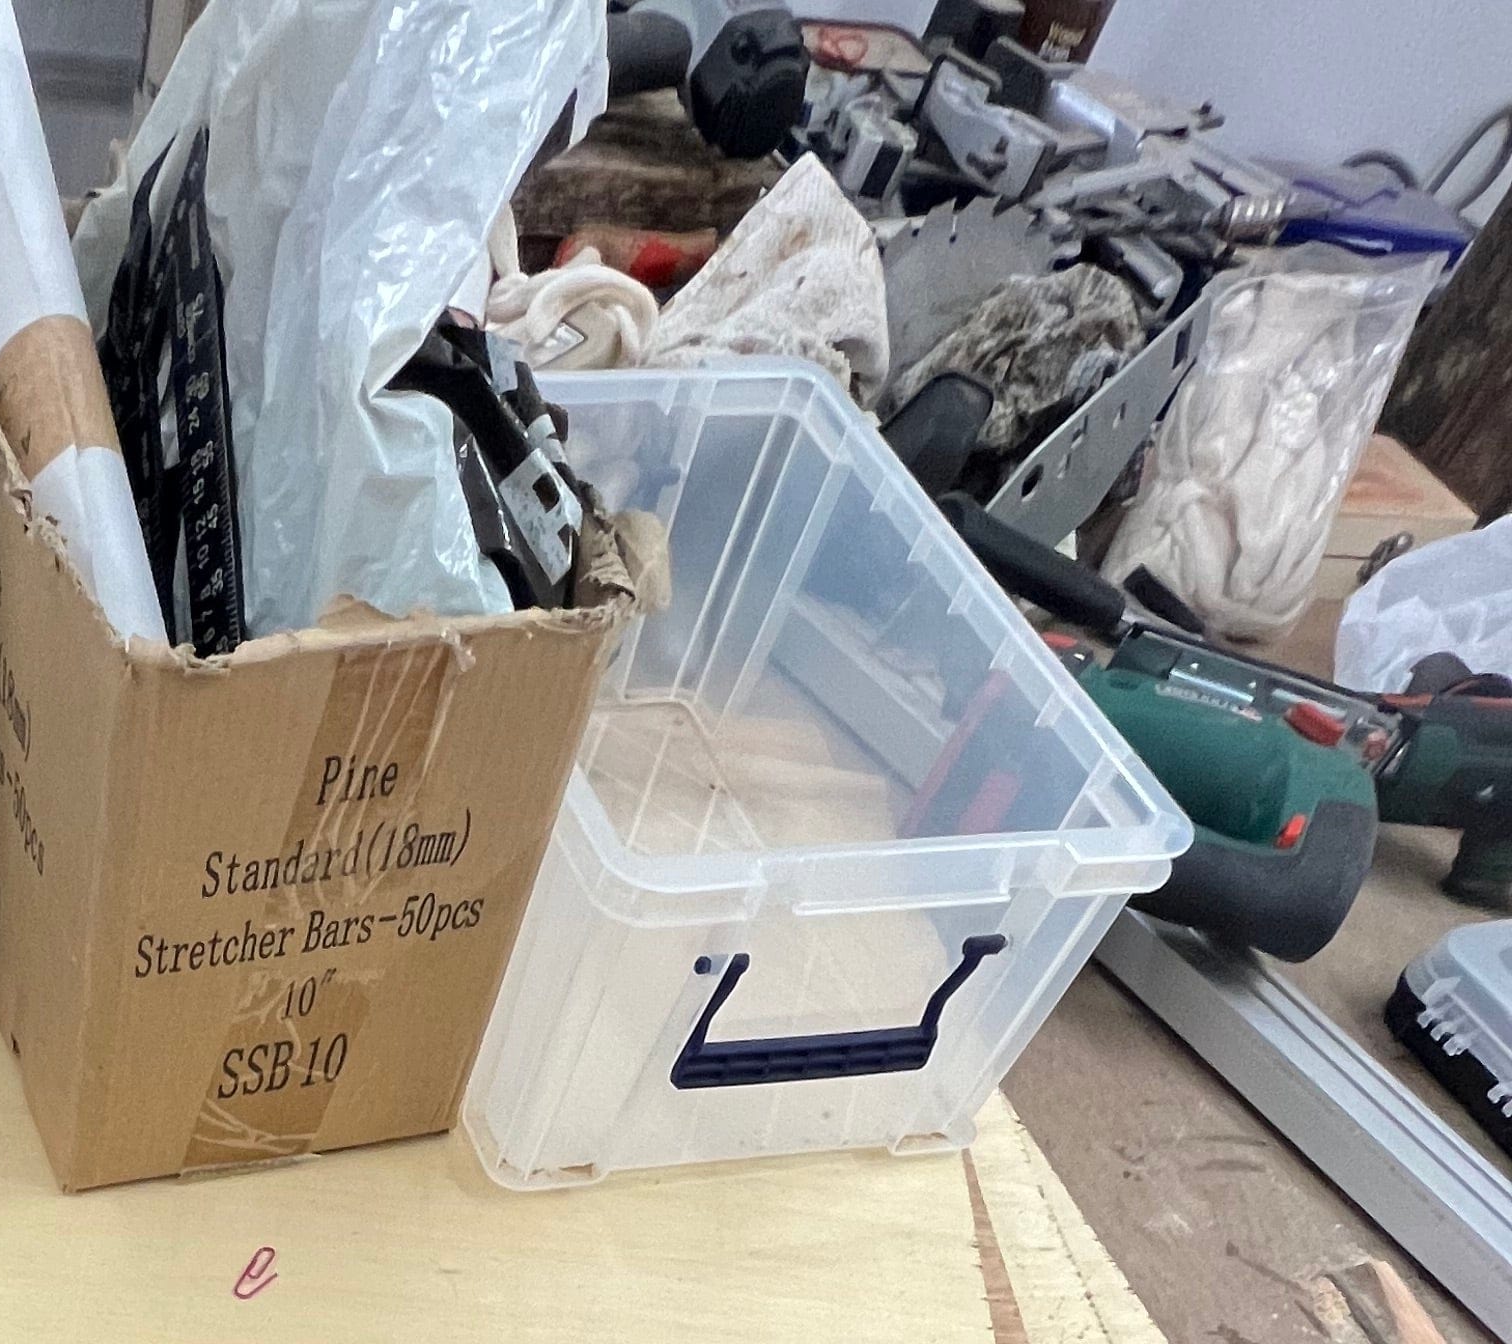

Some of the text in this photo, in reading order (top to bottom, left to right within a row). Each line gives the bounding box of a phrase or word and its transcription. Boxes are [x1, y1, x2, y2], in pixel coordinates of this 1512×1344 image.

[211, 568, 224, 598] 35
[316, 754, 400, 806] Pine
[202, 806, 472, 899] Standard(18mm)
[134, 892, 485, 979] Stretcher Bars-50pcs
[280, 967, 338, 1021] 10"
